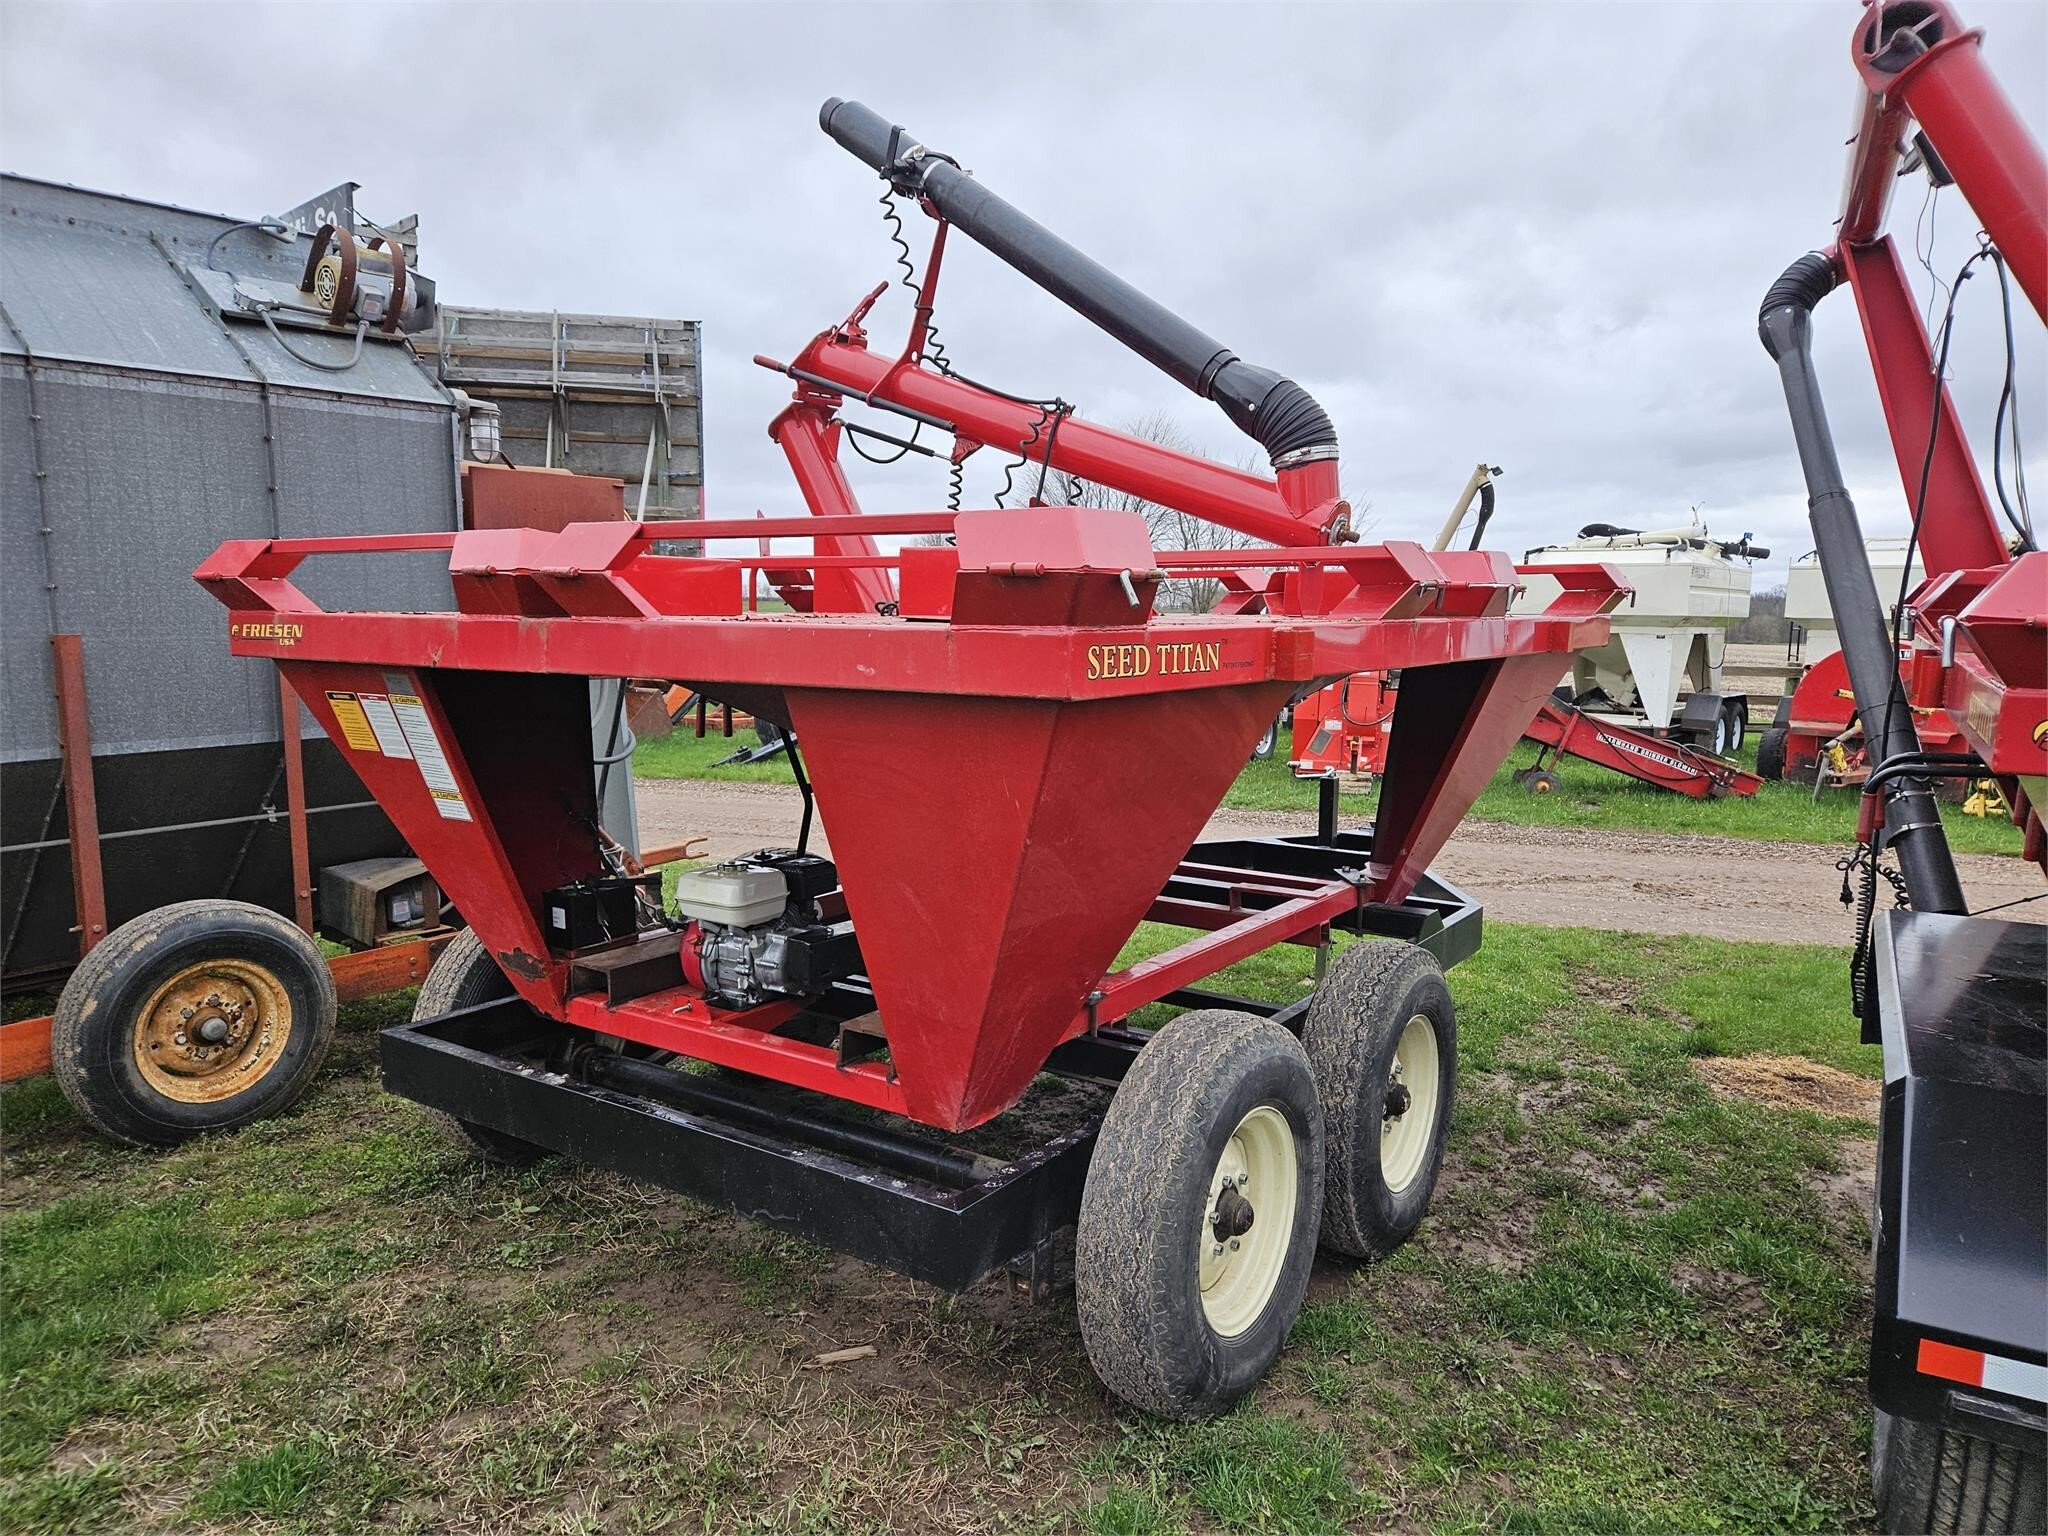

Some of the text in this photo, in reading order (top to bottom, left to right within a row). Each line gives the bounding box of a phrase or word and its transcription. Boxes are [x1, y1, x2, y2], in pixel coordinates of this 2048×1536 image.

[242, 624, 303, 638] FRIESEN
[279, 638, 295, 646] USA
[1086, 642, 1221, 681] SEED TITAN
